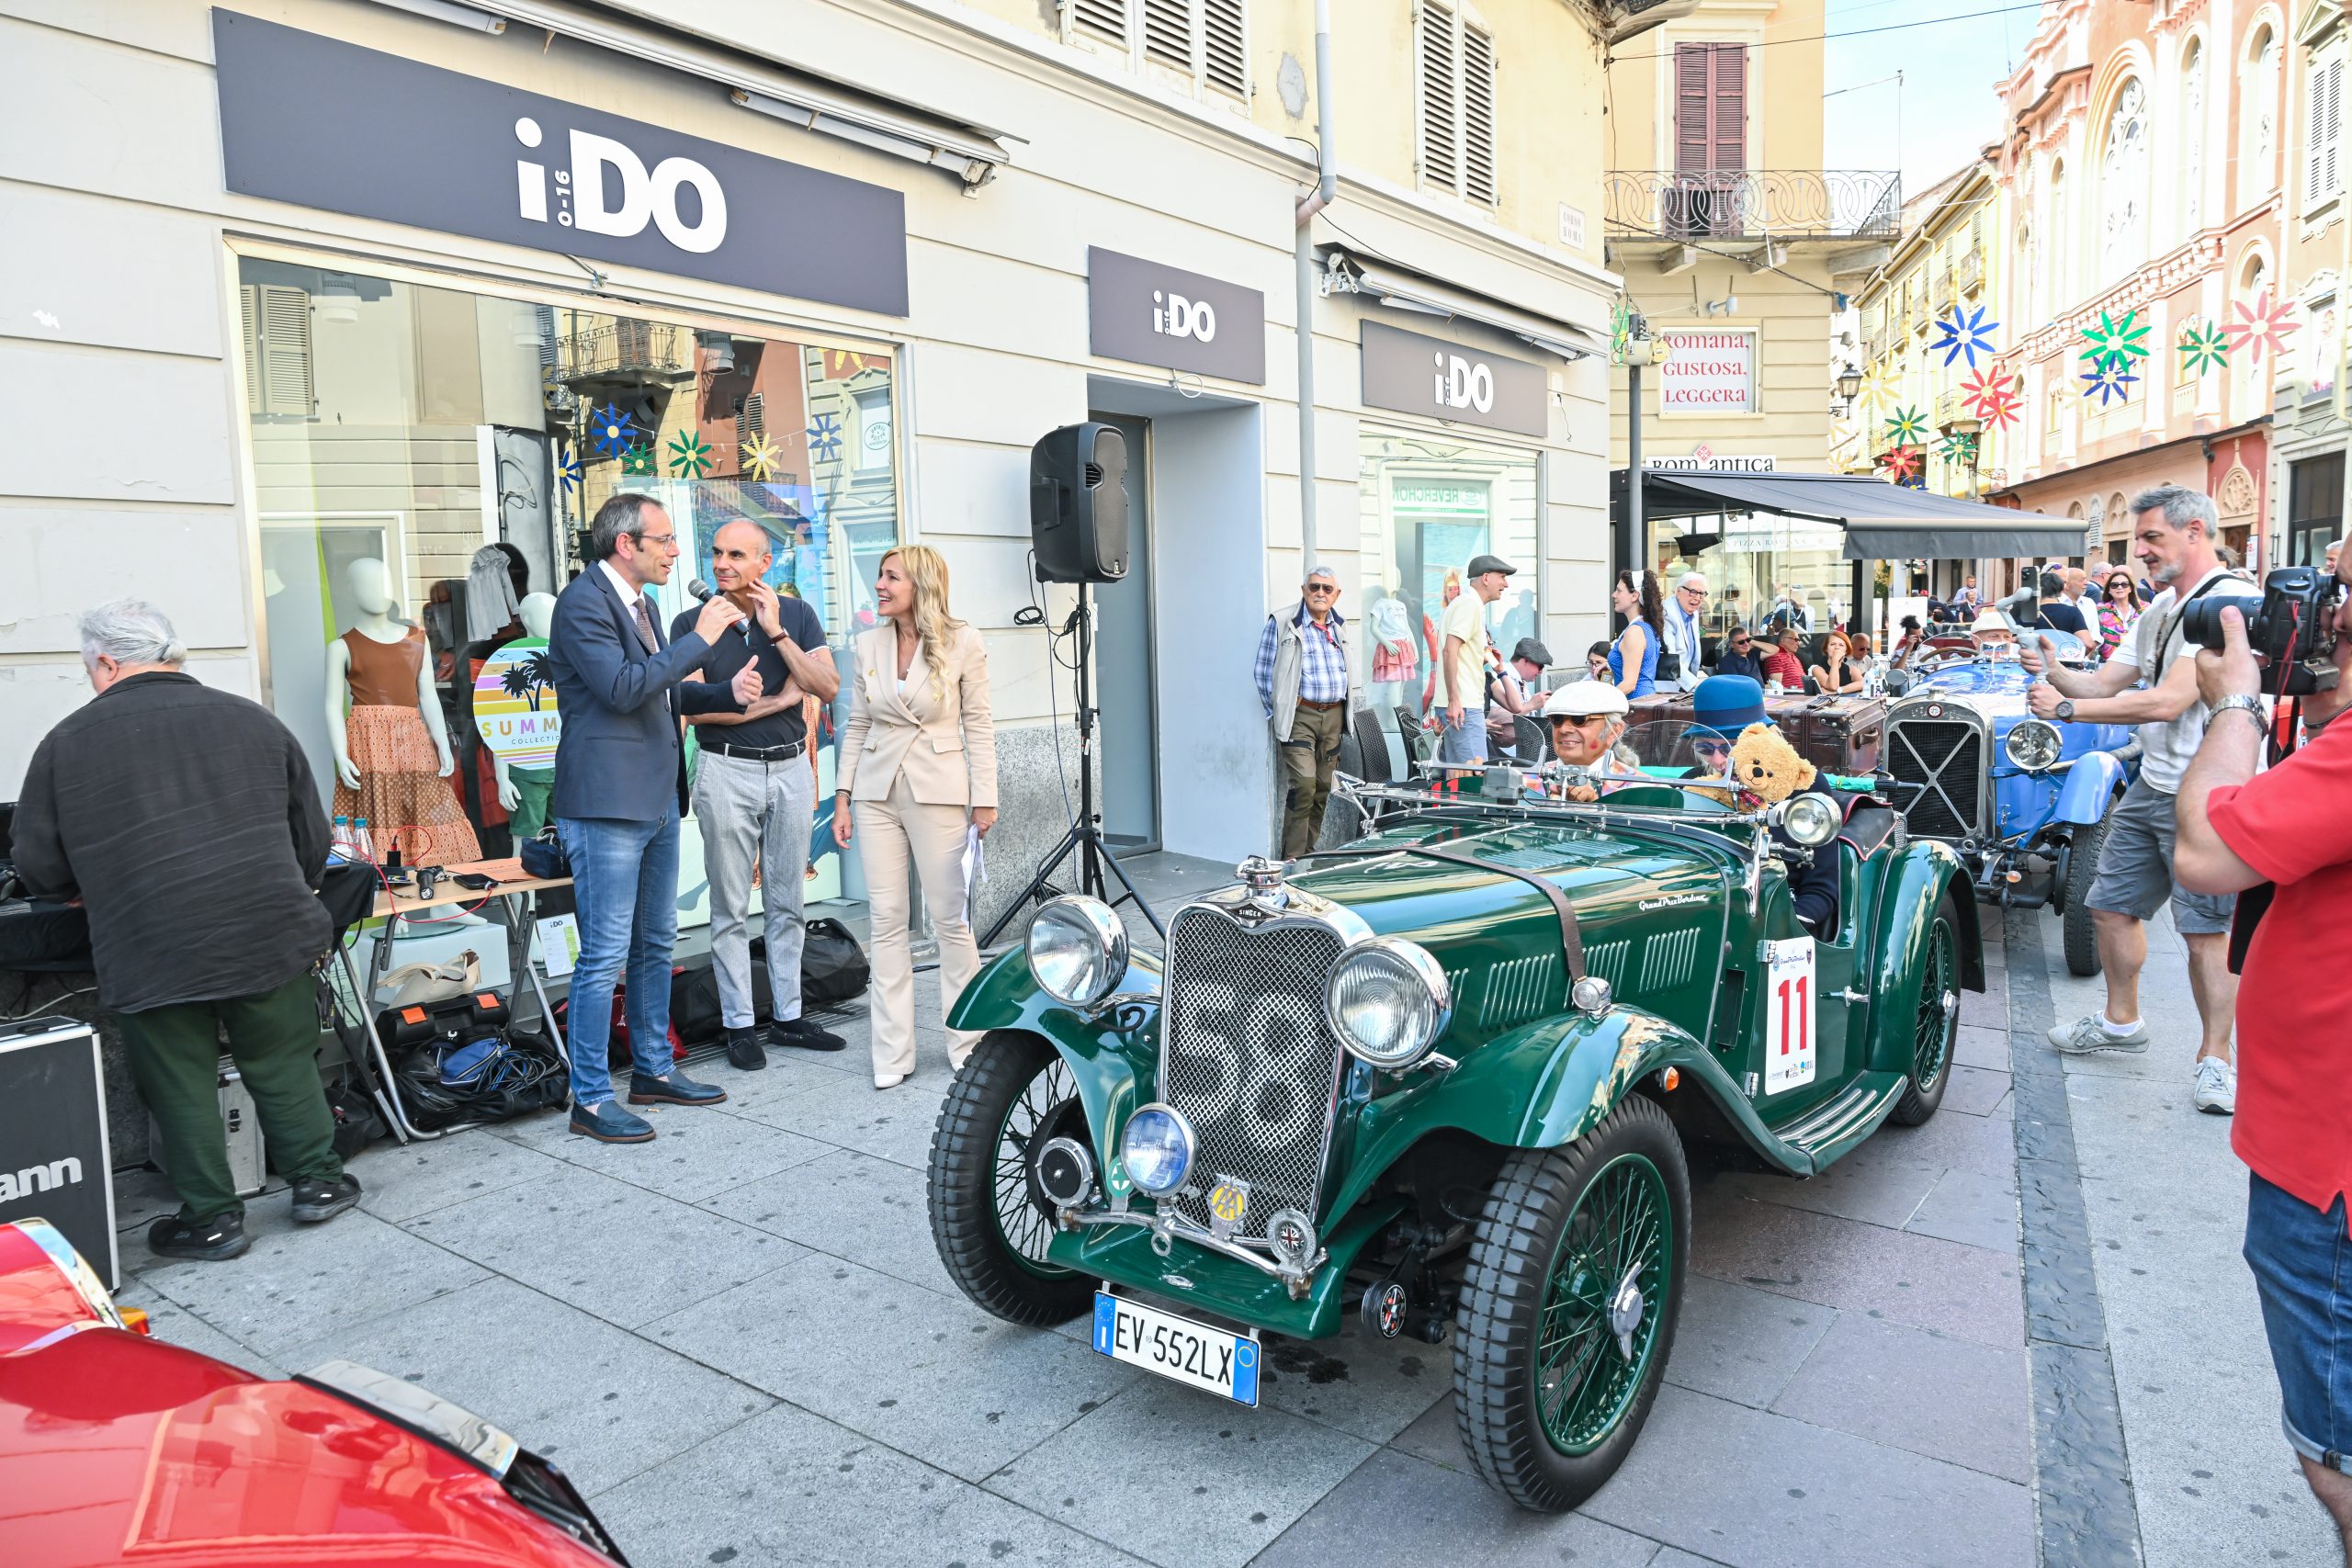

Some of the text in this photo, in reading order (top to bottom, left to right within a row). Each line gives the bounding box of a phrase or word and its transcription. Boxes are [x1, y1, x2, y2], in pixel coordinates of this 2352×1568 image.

[554, 169, 573, 228] 0-16
[1238, 909, 1262, 918] SINGER
[1778, 976, 1807, 1056] 11
